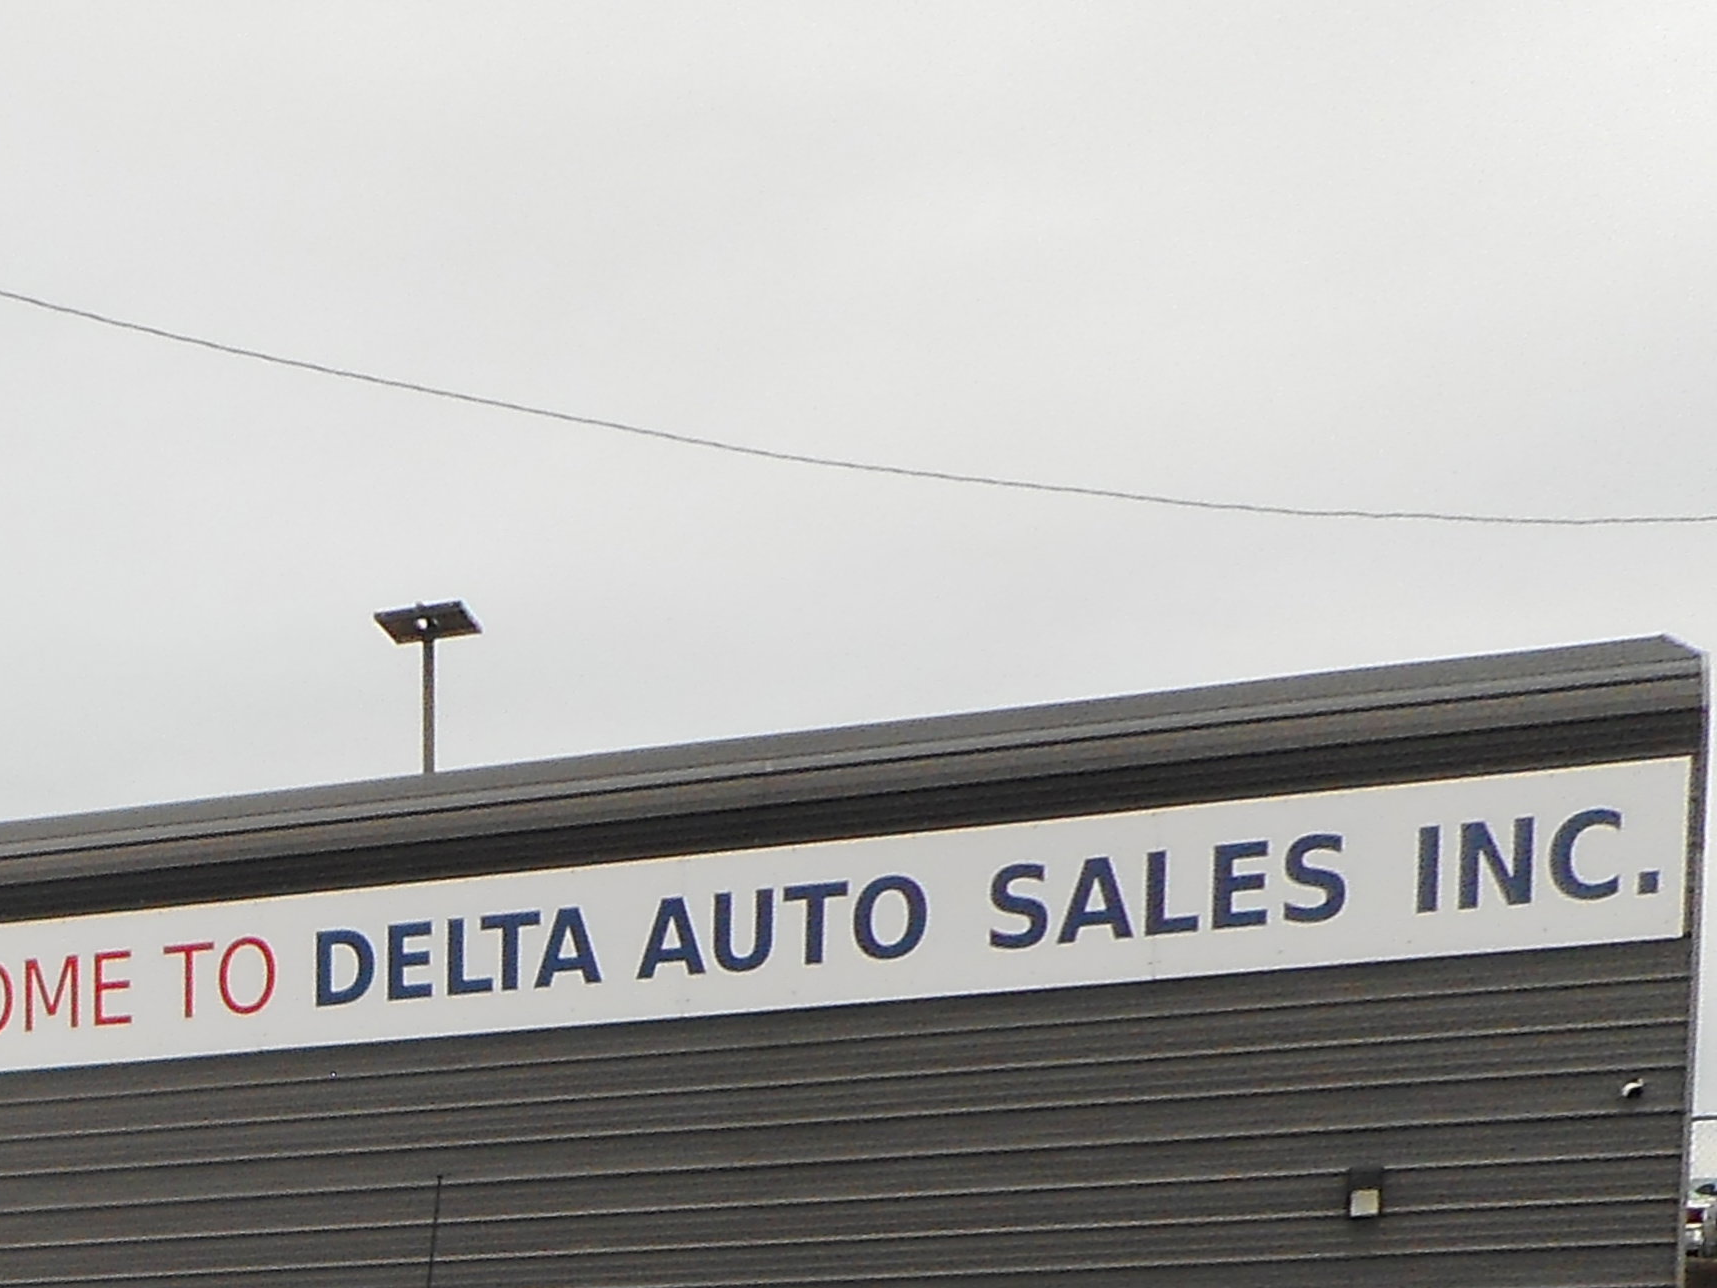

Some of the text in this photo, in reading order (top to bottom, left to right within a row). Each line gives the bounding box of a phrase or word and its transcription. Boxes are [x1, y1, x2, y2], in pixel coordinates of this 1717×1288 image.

[164, 935, 276, 1018] TO
[314, 906, 602, 1006] DELTA
[637, 874, 928, 979] AUTO
[988, 833, 1347, 949] SALES
[1416, 808, 1660, 914] INC.
